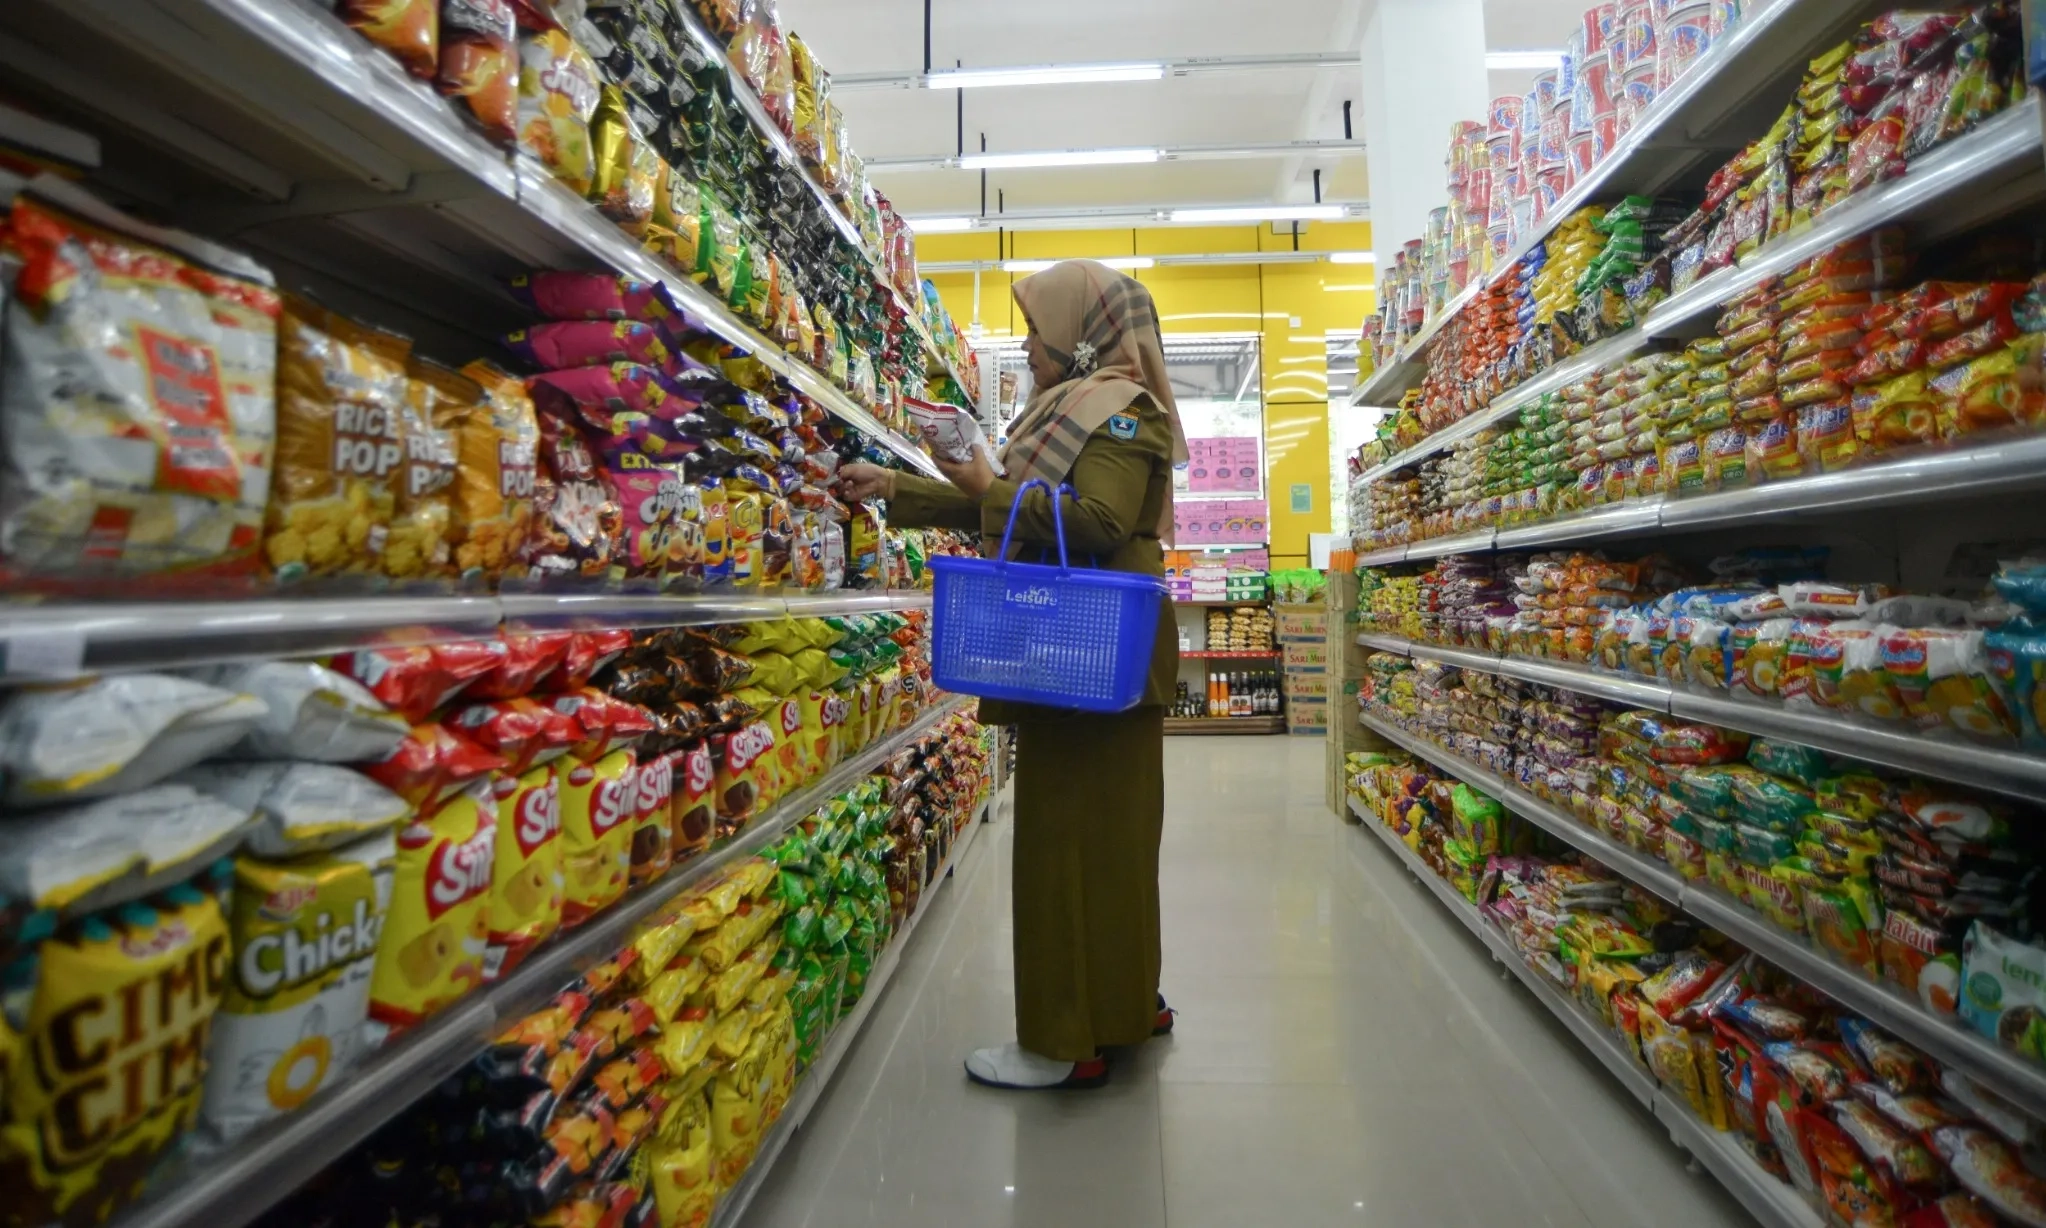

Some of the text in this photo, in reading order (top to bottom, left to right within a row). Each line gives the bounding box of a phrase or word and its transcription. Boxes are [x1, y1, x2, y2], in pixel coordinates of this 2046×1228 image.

[335, 402, 399, 440] RICE
[335, 437, 400, 476] POP
[1005, 588, 1058, 607] Leisure
[1284, 624, 1303, 634] SARI
[1290, 654, 1309, 664] SARI
[1294, 684, 1313, 694] SARI
[1296, 715, 1315, 725] SARI
[1520, 766, 1533, 783] 2
